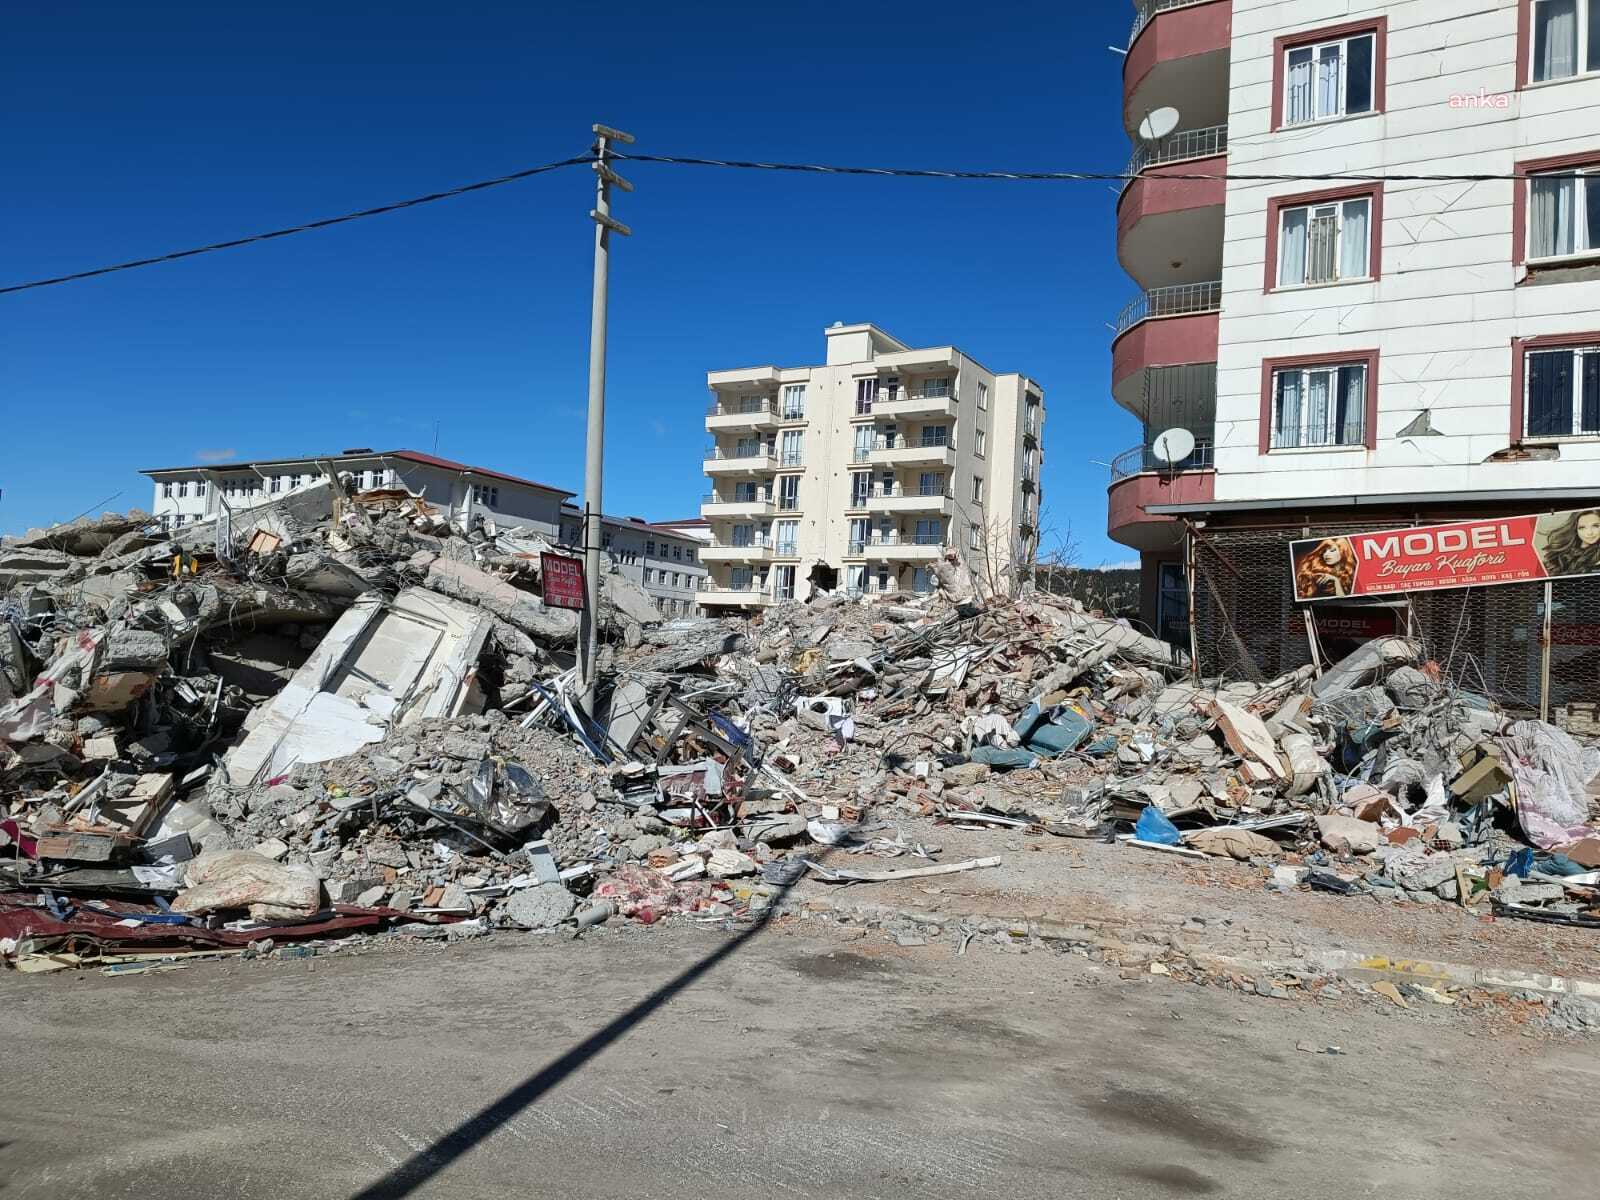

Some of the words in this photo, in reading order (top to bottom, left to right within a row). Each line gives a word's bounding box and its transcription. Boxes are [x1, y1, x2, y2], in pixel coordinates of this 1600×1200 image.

[1363, 524, 1525, 560] MODEL
[543, 559, 580, 576] MODEL
[1377, 559, 1432, 578] Bayan
[1317, 619, 1371, 628] MODEL
